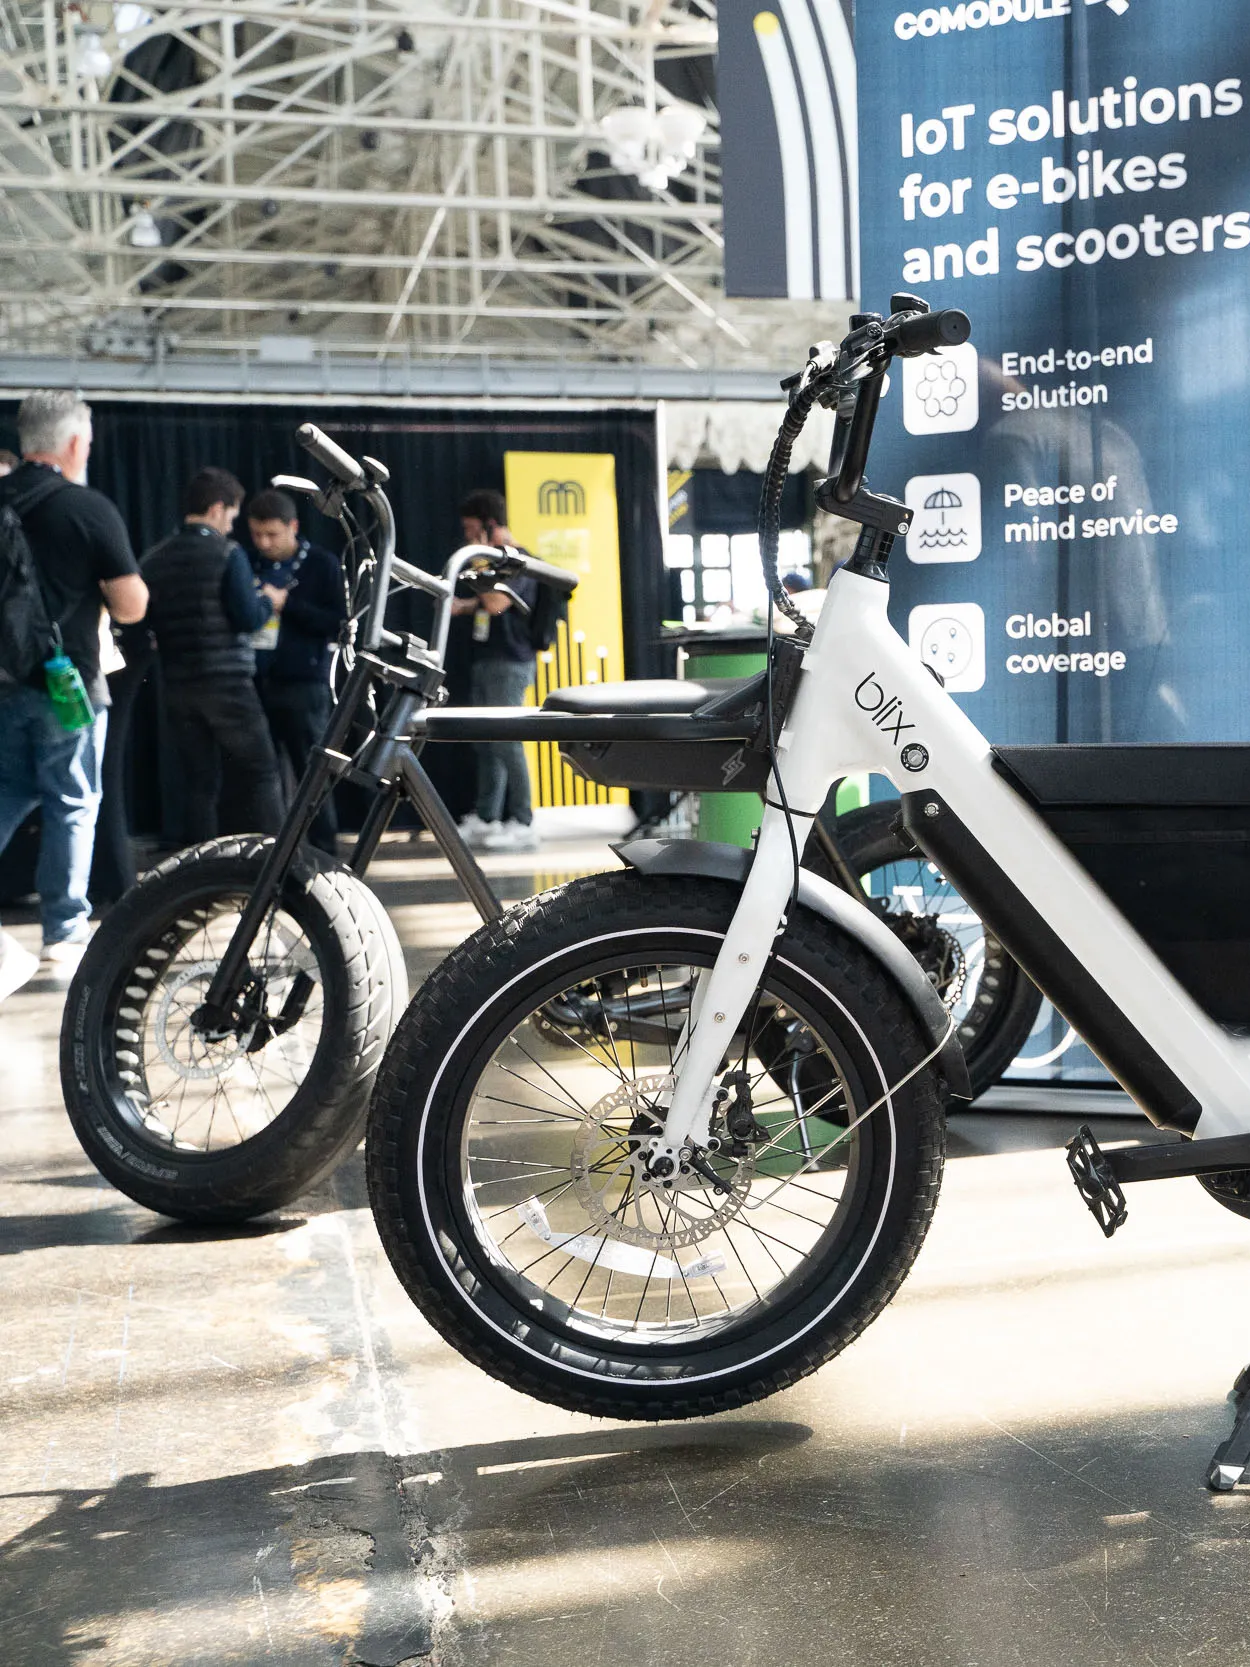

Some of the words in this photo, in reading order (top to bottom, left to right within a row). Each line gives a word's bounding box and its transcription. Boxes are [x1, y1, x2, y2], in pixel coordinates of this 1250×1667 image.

[894, 0, 1072, 40] COMODULE
[899, 102, 976, 158] IoT
[988, 75, 1244, 143] solutions
[898, 171, 973, 221] for
[985, 148, 1188, 211] e-bikes
[901, 226, 1001, 285] and
[1000, 337, 1155, 378] End-to-end
[1000, 380, 1109, 412] solution
[1003, 482, 1087, 509] Peace
[1089, 474, 1118, 503] of
[1003, 513, 1077, 544] mind
[1080, 507, 1180, 540] service
[1005, 610, 1092, 641] Global
[1004, 649, 1128, 678] coverage
[854, 671, 917, 747] blix
